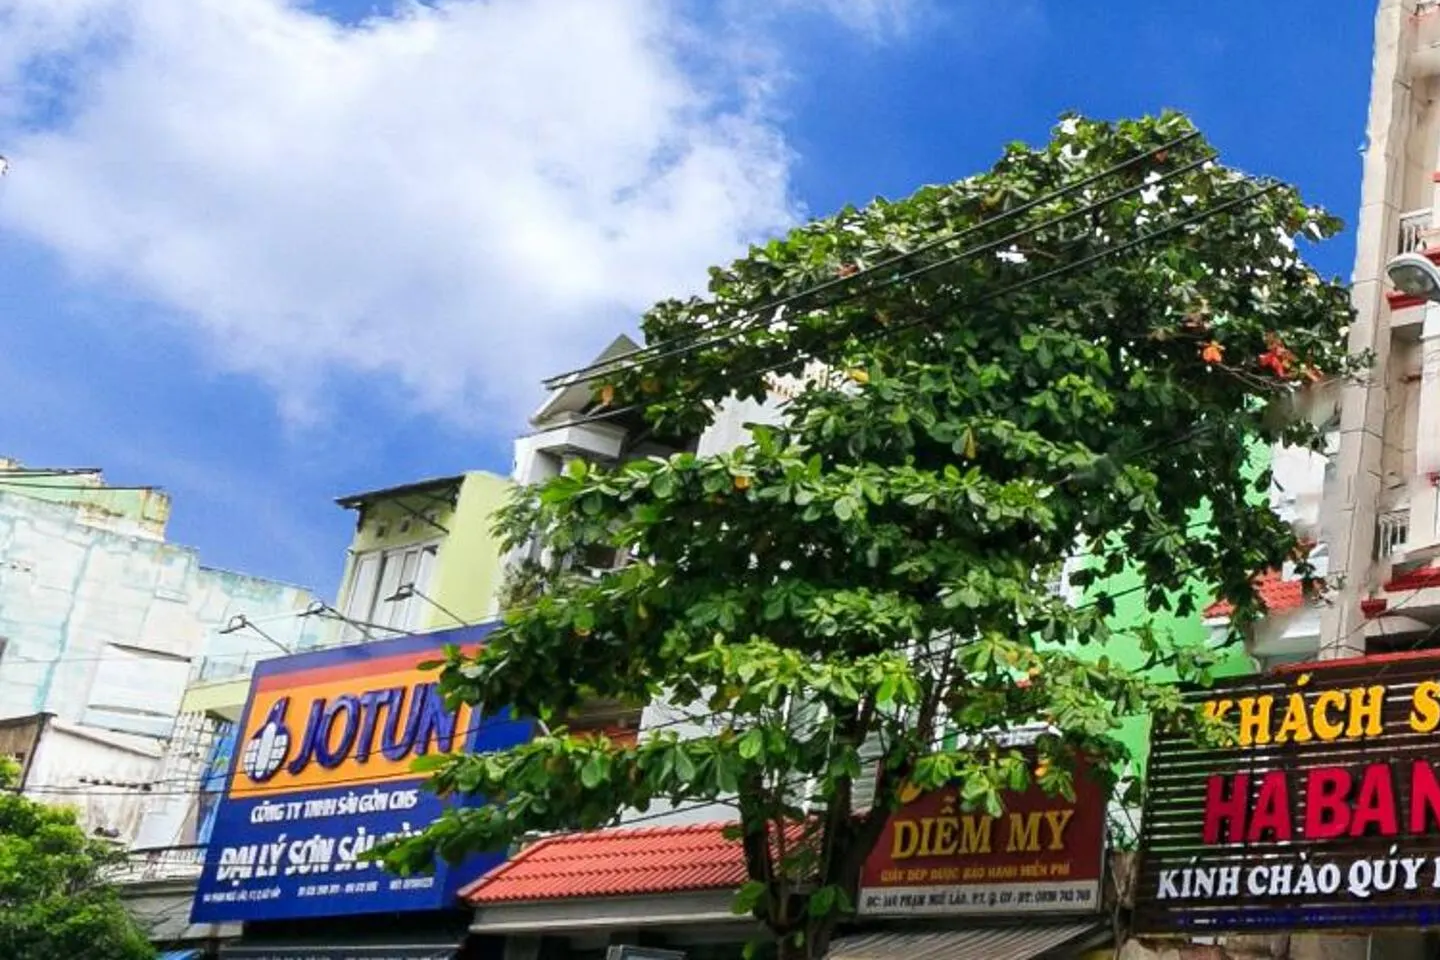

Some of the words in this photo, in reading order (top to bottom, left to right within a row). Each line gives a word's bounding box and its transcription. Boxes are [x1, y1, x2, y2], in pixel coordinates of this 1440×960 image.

[288, 681, 462, 776] JOTUN
[1203, 671, 1386, 748] KHÁCH
[286, 802, 303, 820] TY
[890, 795, 993, 860] DIỄM
[1005, 808, 1075, 853] MY
[216, 844, 257, 887] ĐẠI
[255, 833, 288, 877] LÝ
[285, 833, 333, 876] SƠN
[1156, 855, 1241, 900] KÍNH
[1247, 851, 1341, 896] CHÀO
[1347, 842, 1426, 899] QÚY
